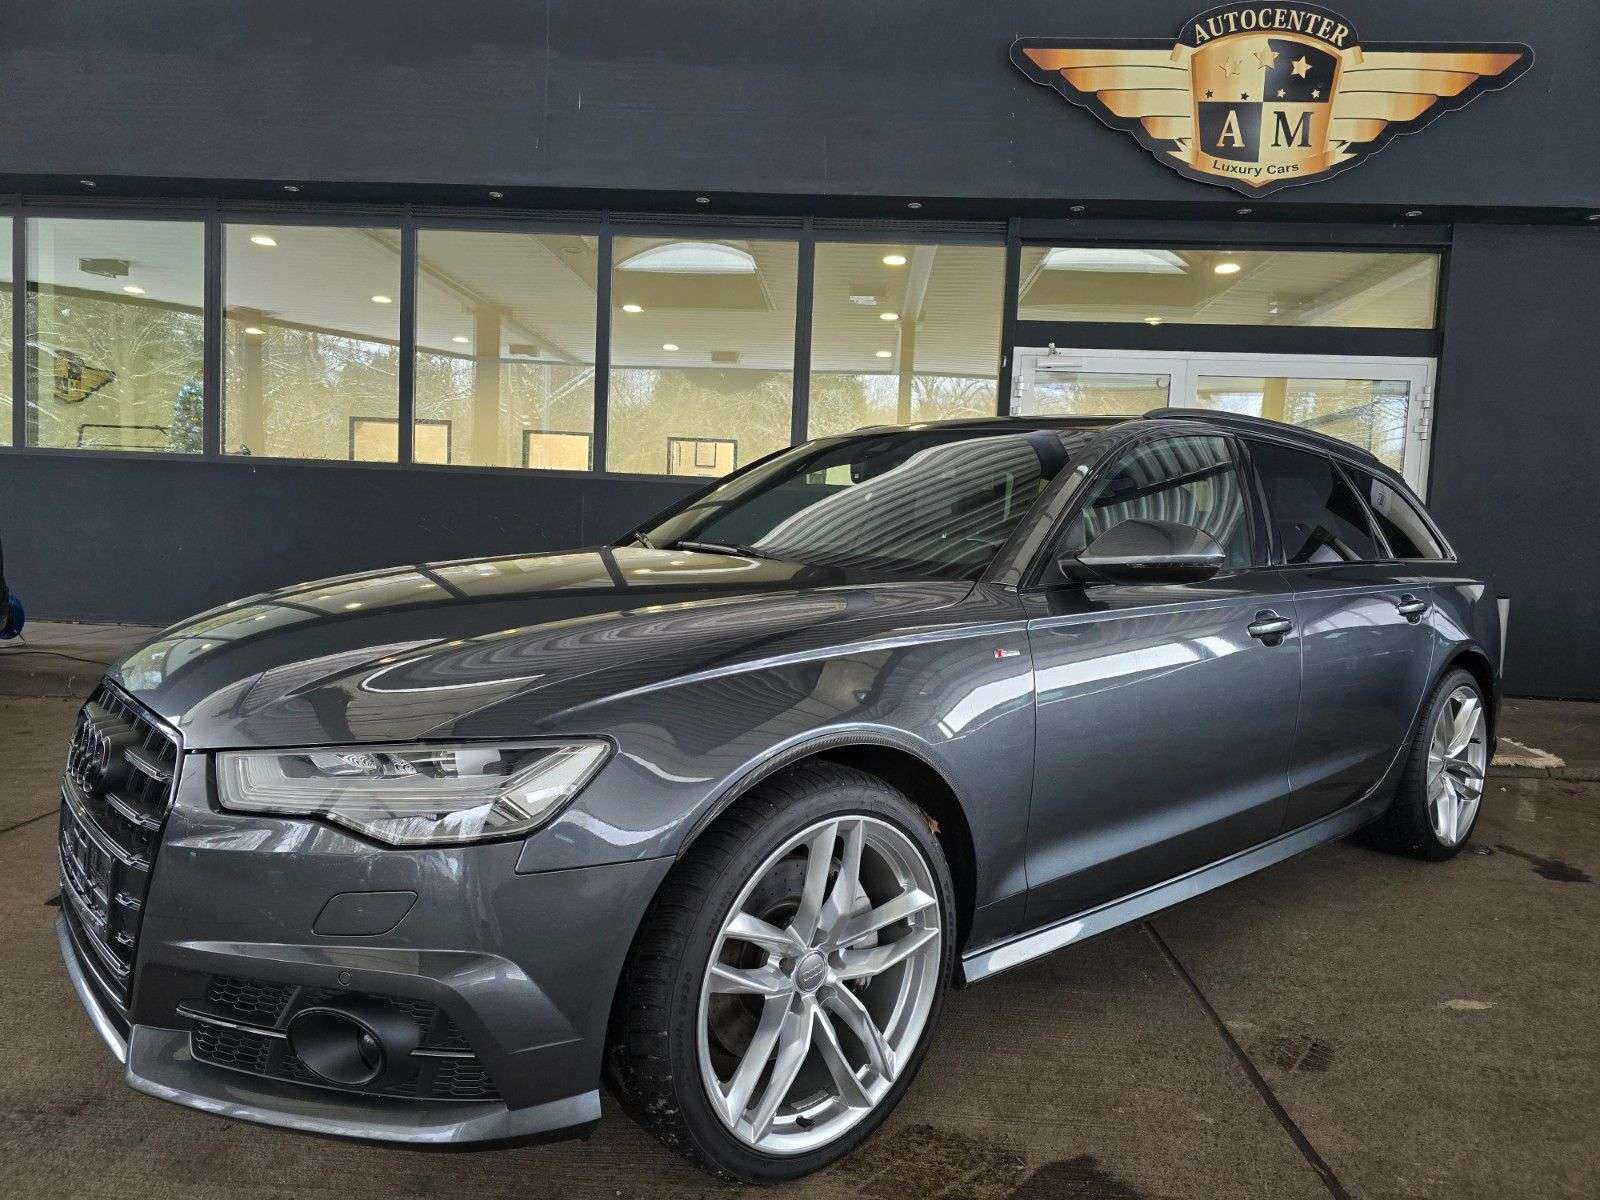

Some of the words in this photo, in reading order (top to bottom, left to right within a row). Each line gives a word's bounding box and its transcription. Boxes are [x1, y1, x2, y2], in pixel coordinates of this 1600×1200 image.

[1194, 8, 1349, 47] AUTOCENTER
[1215, 110, 1246, 148] A
[1271, 111, 1315, 148] M
[1212, 159, 1262, 177] Luxury
[1266, 163, 1300, 175] Cars
